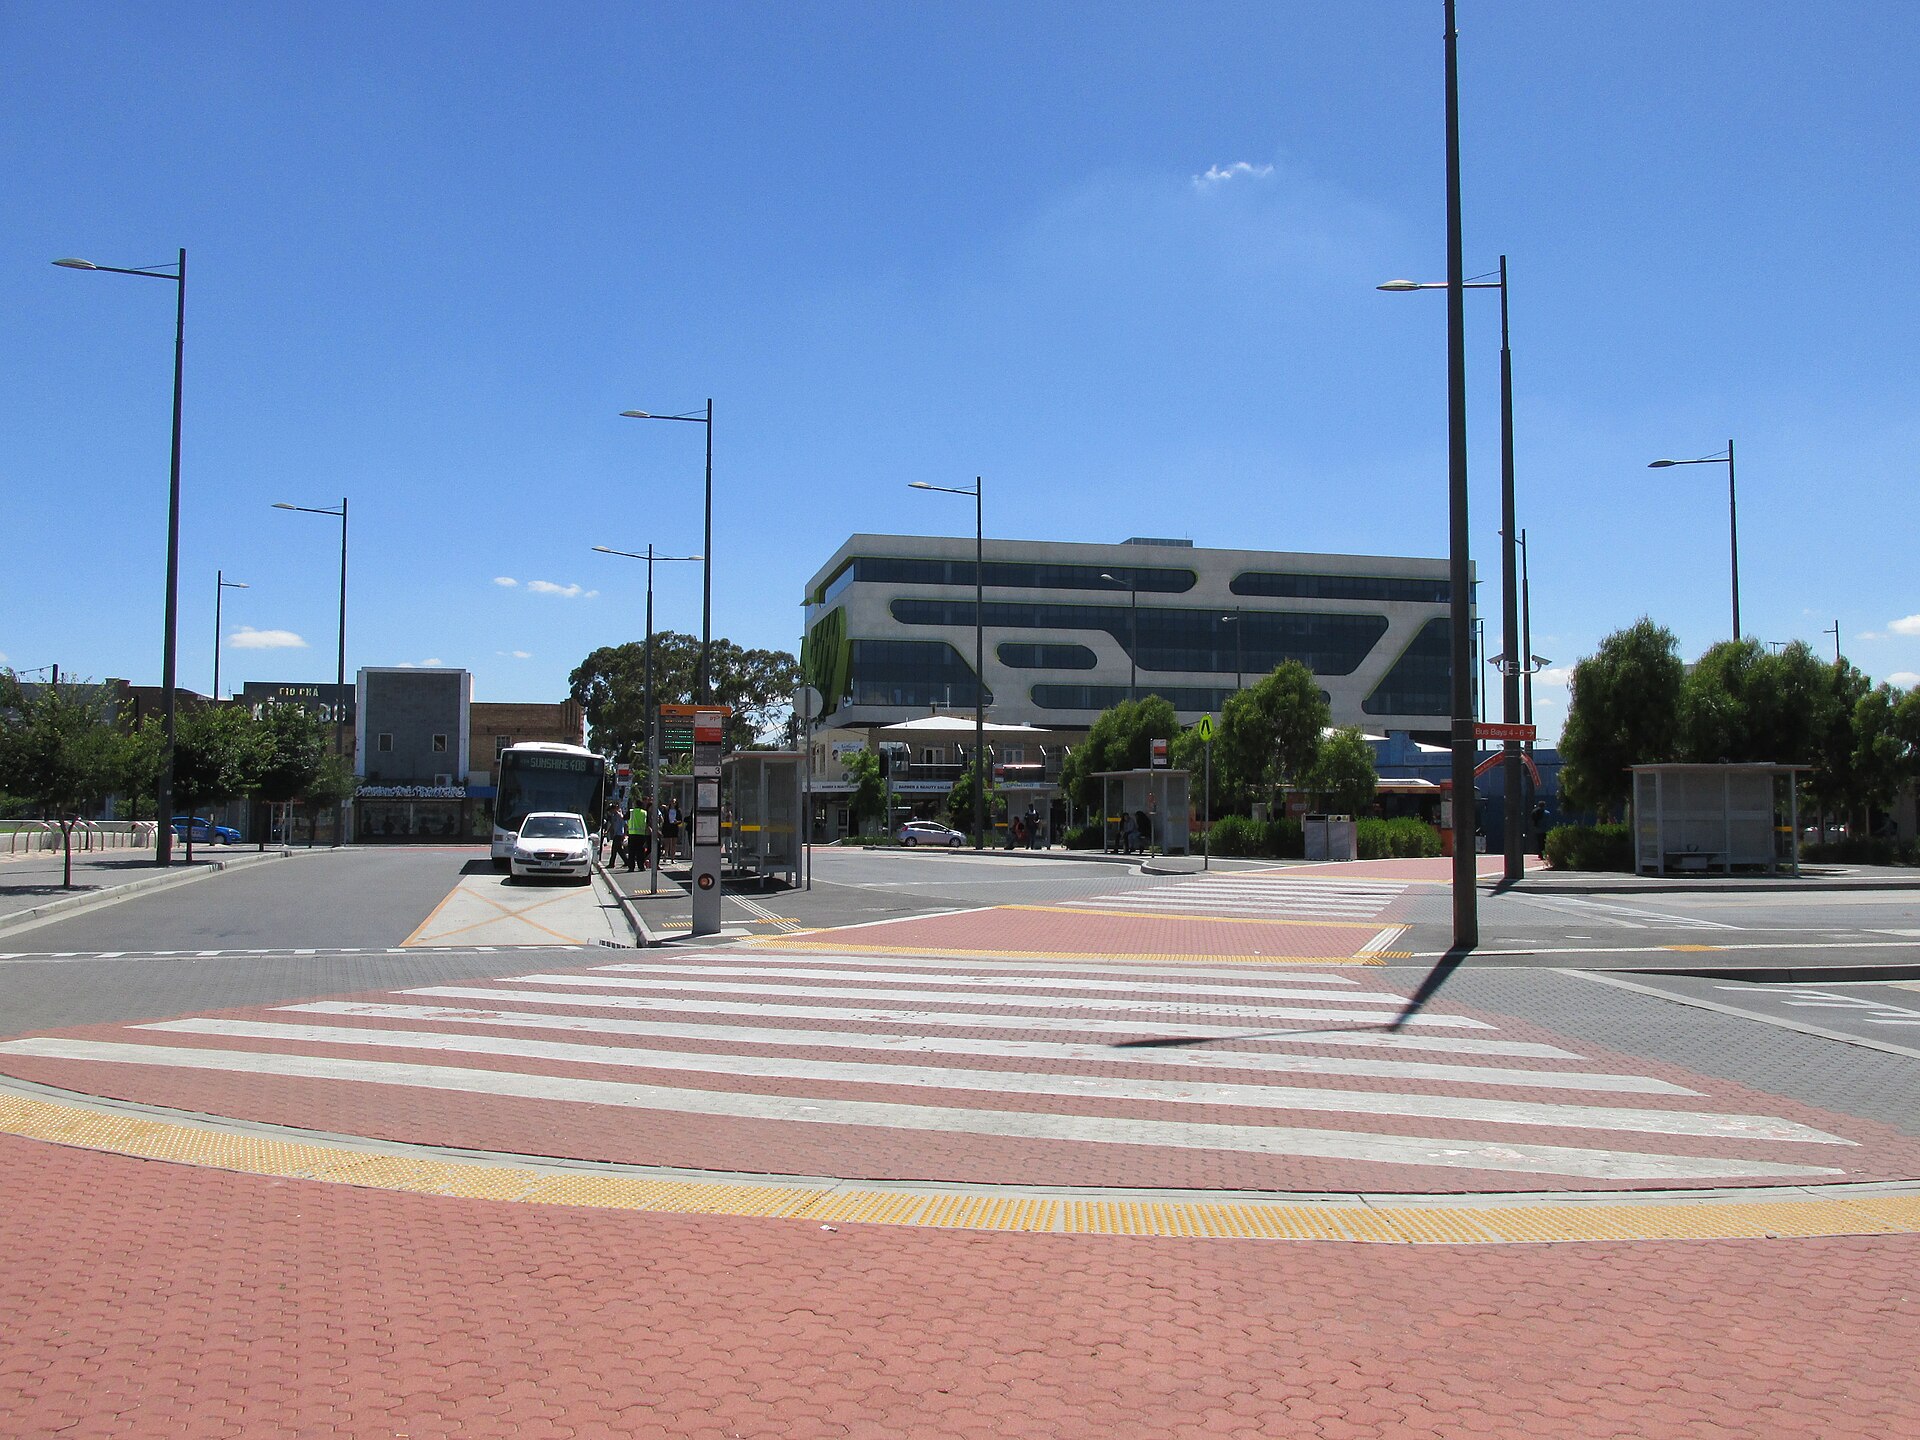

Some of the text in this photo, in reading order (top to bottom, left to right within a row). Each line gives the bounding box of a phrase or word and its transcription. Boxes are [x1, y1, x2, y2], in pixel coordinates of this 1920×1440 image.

[1475, 727, 1489, 735] Bus
[1490, 728, 1507, 737] Bays
[530, 757, 569, 770] SUNSHINE
[714, 766, 721, 775] 3
